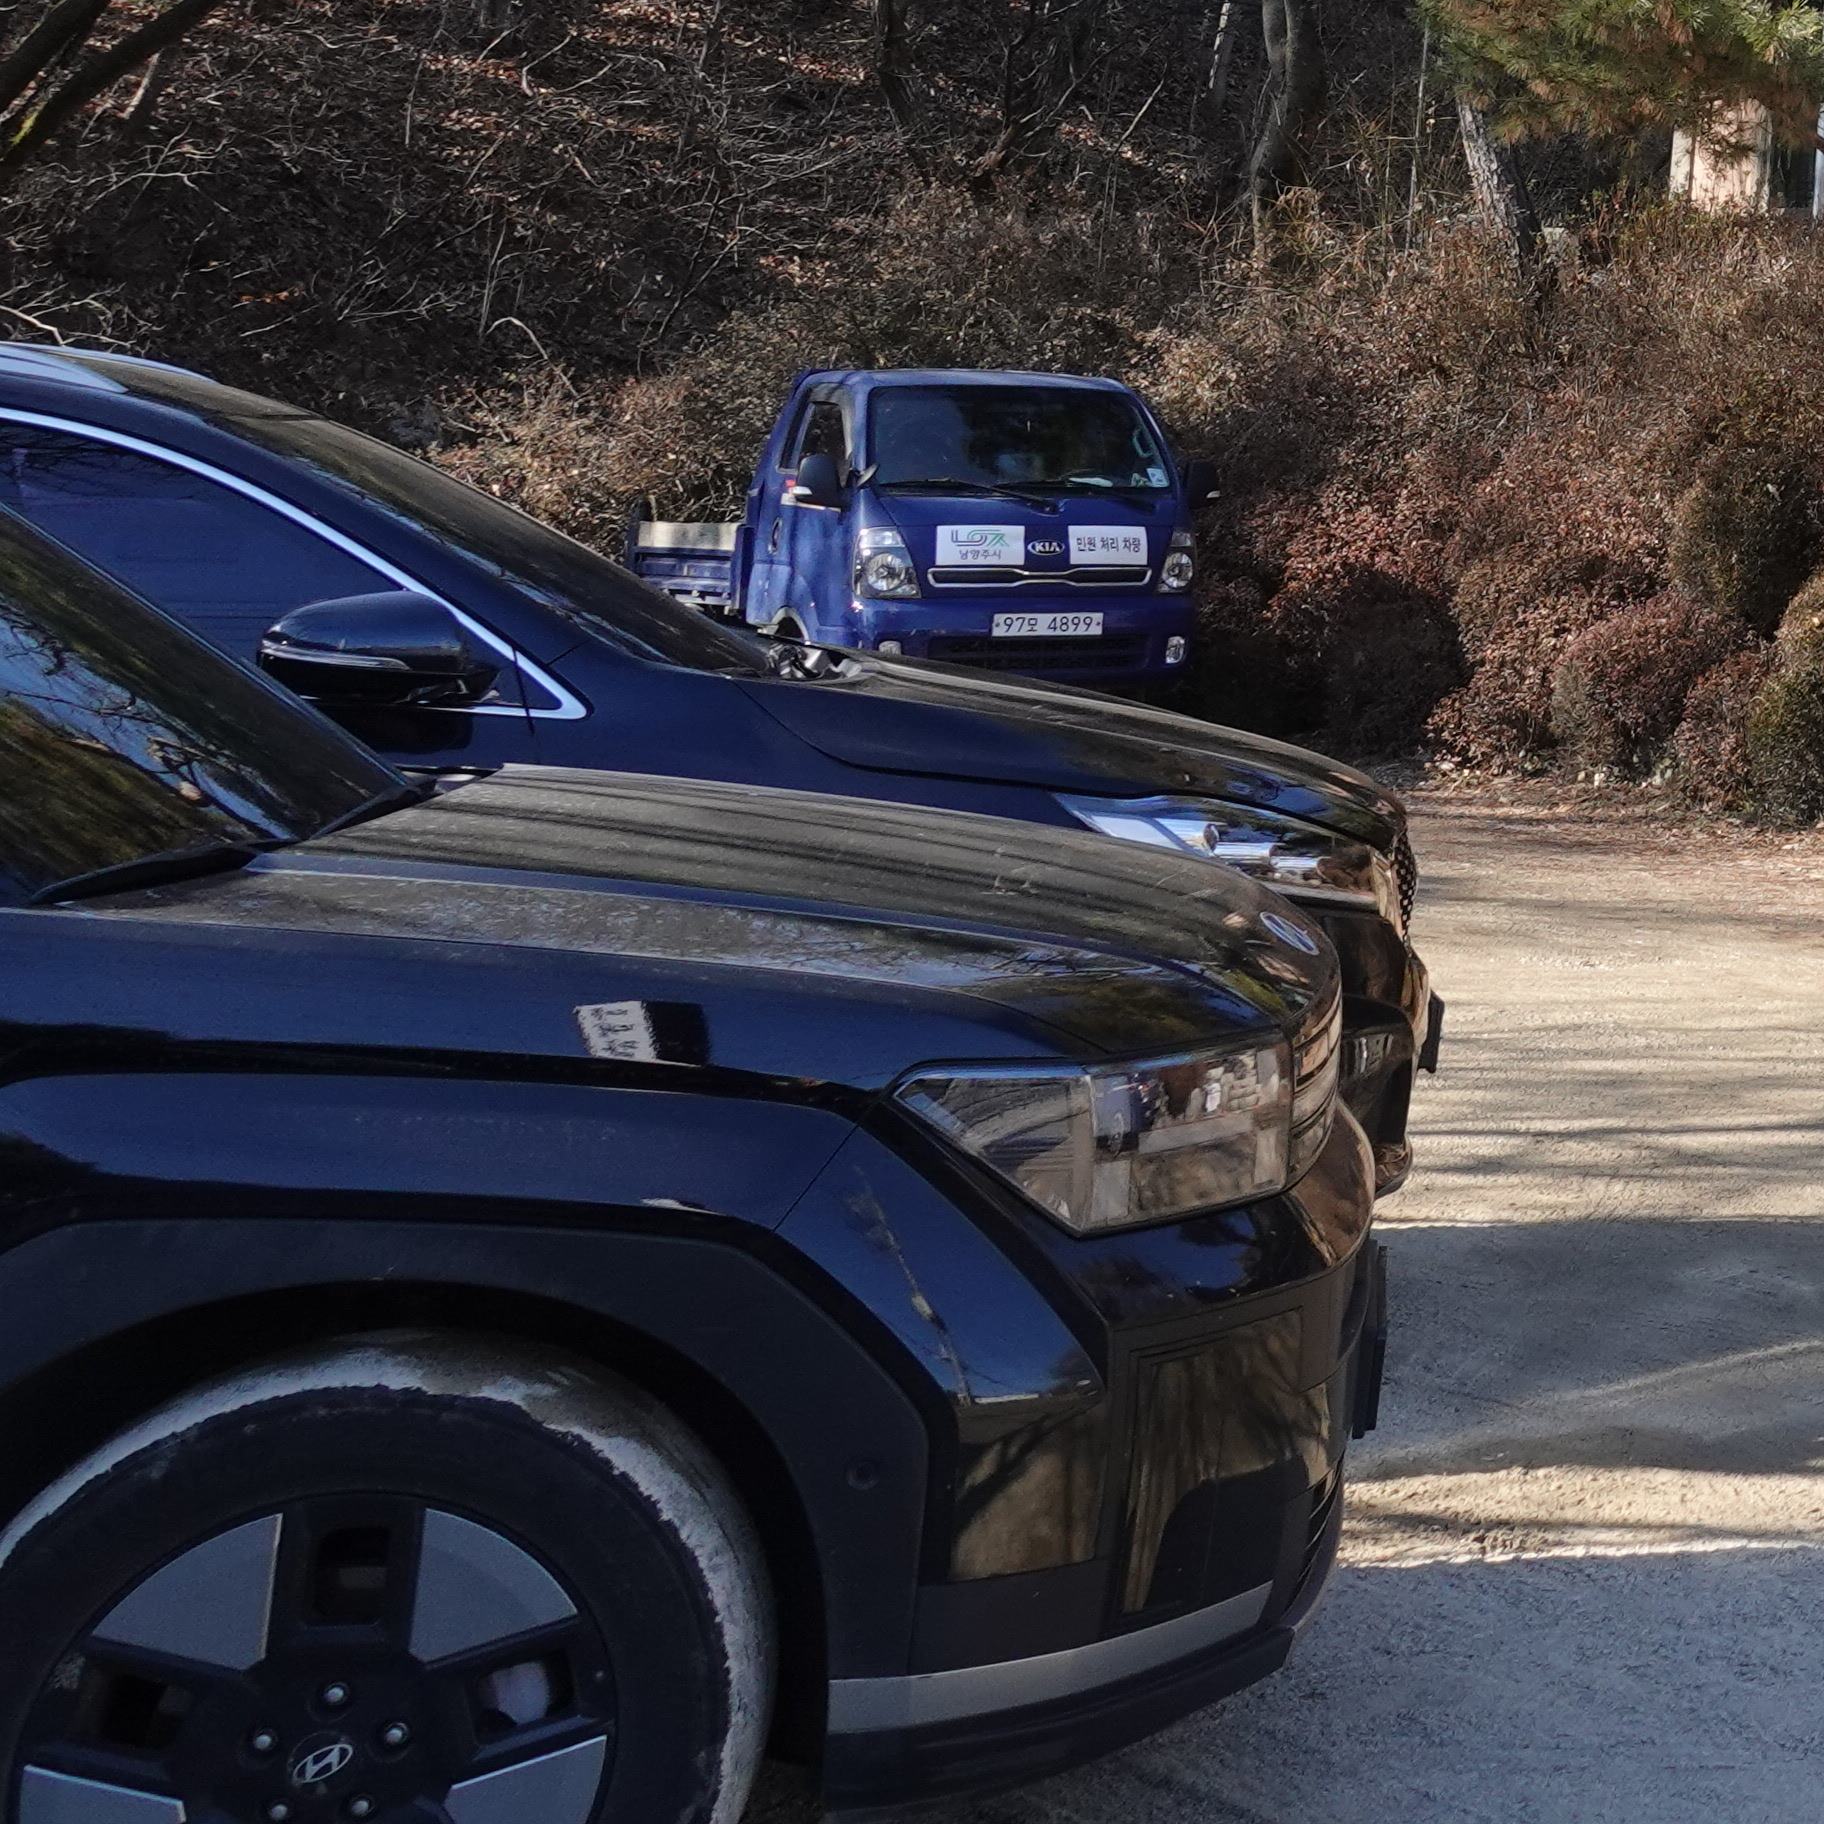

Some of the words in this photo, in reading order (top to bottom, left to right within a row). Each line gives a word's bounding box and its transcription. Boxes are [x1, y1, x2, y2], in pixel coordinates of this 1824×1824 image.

[1034, 542, 1061, 553] KIA
[1076, 537, 1096, 552] 민원
[1100, 537, 1119, 552] 처리
[1122, 537, 1141, 553] 차량
[959, 549, 1002, 561] 남양주시
[1003, 616, 1039, 633] 97모
[1047, 616, 1093, 632] 4899
